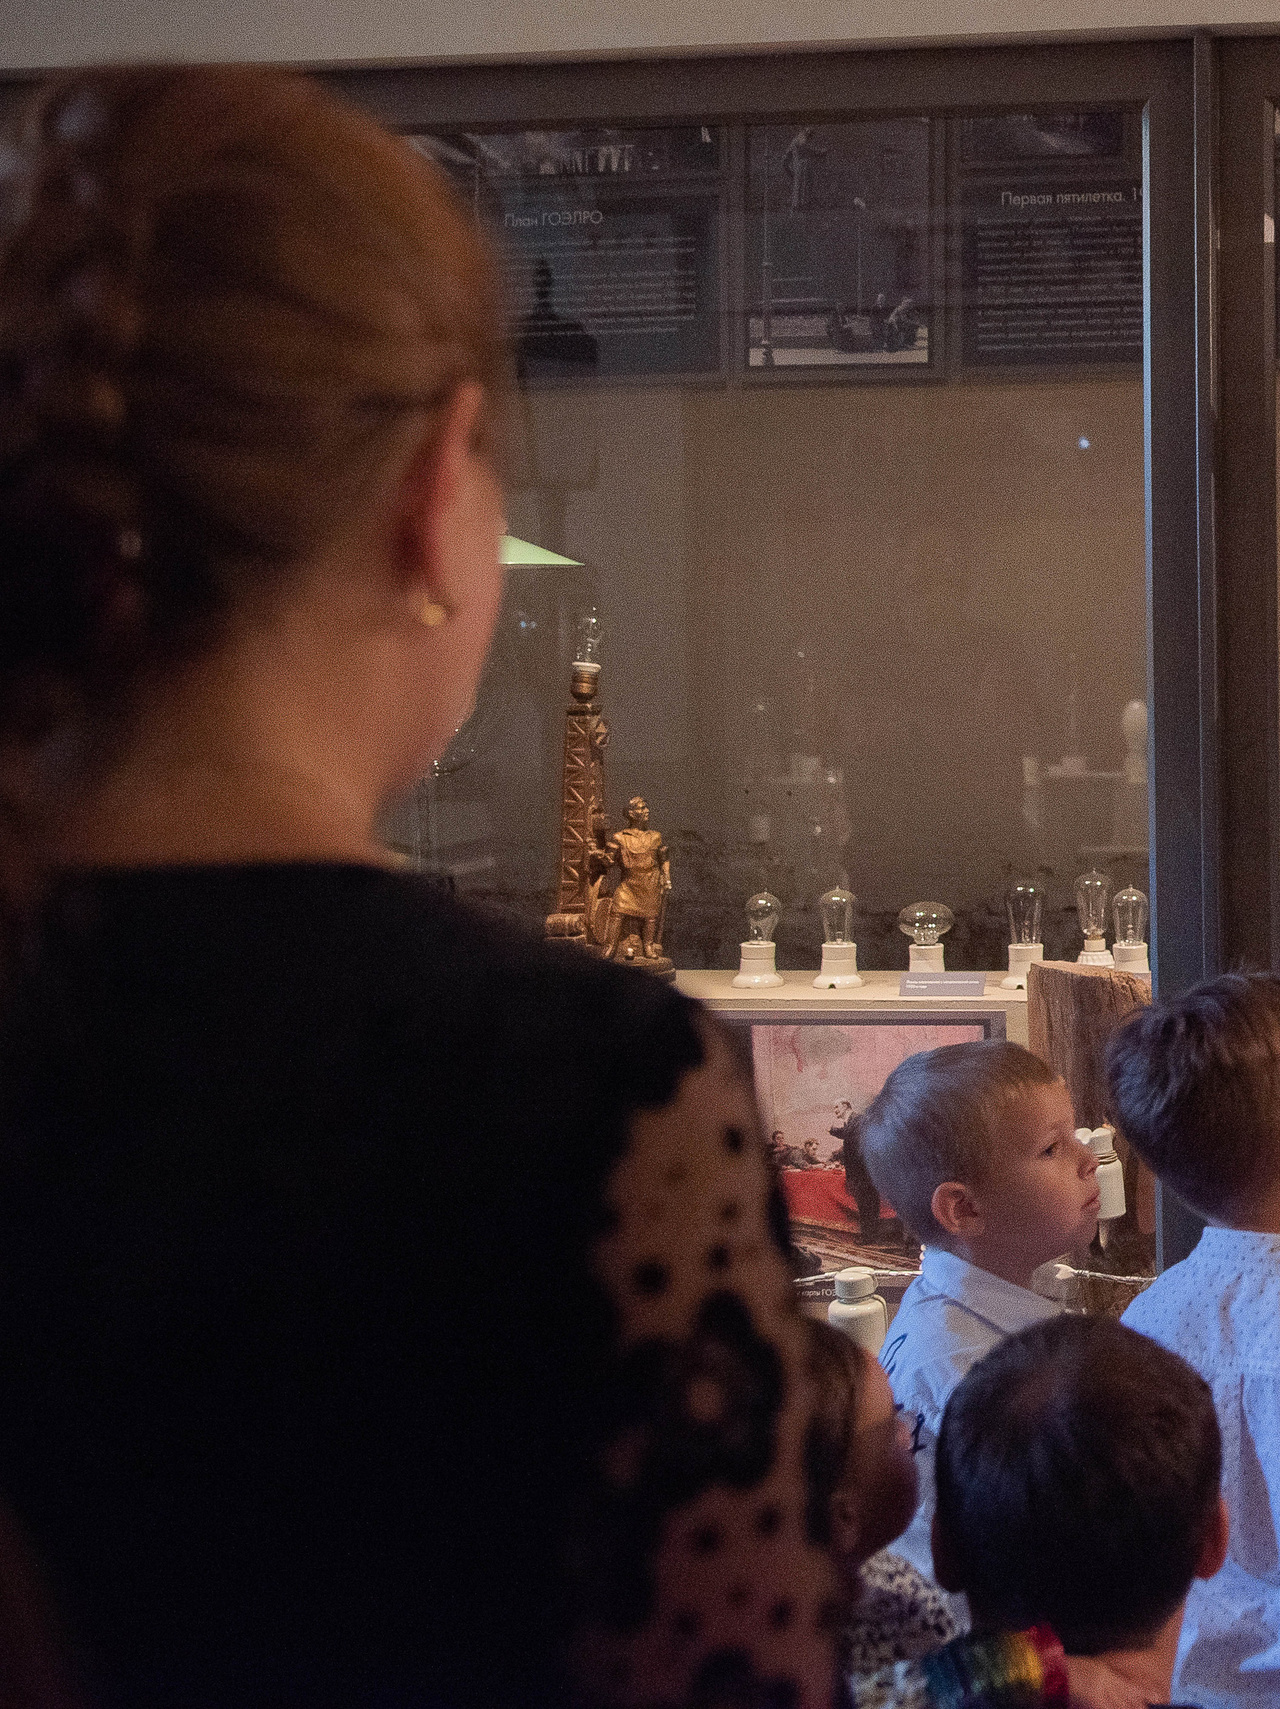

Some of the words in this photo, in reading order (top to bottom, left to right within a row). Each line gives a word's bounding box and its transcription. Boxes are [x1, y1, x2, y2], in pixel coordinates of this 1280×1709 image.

[1001, 191, 1053, 209] Первая
[503, 213, 538, 228] План
[541, 209, 604, 227] ГОЭЛРО
